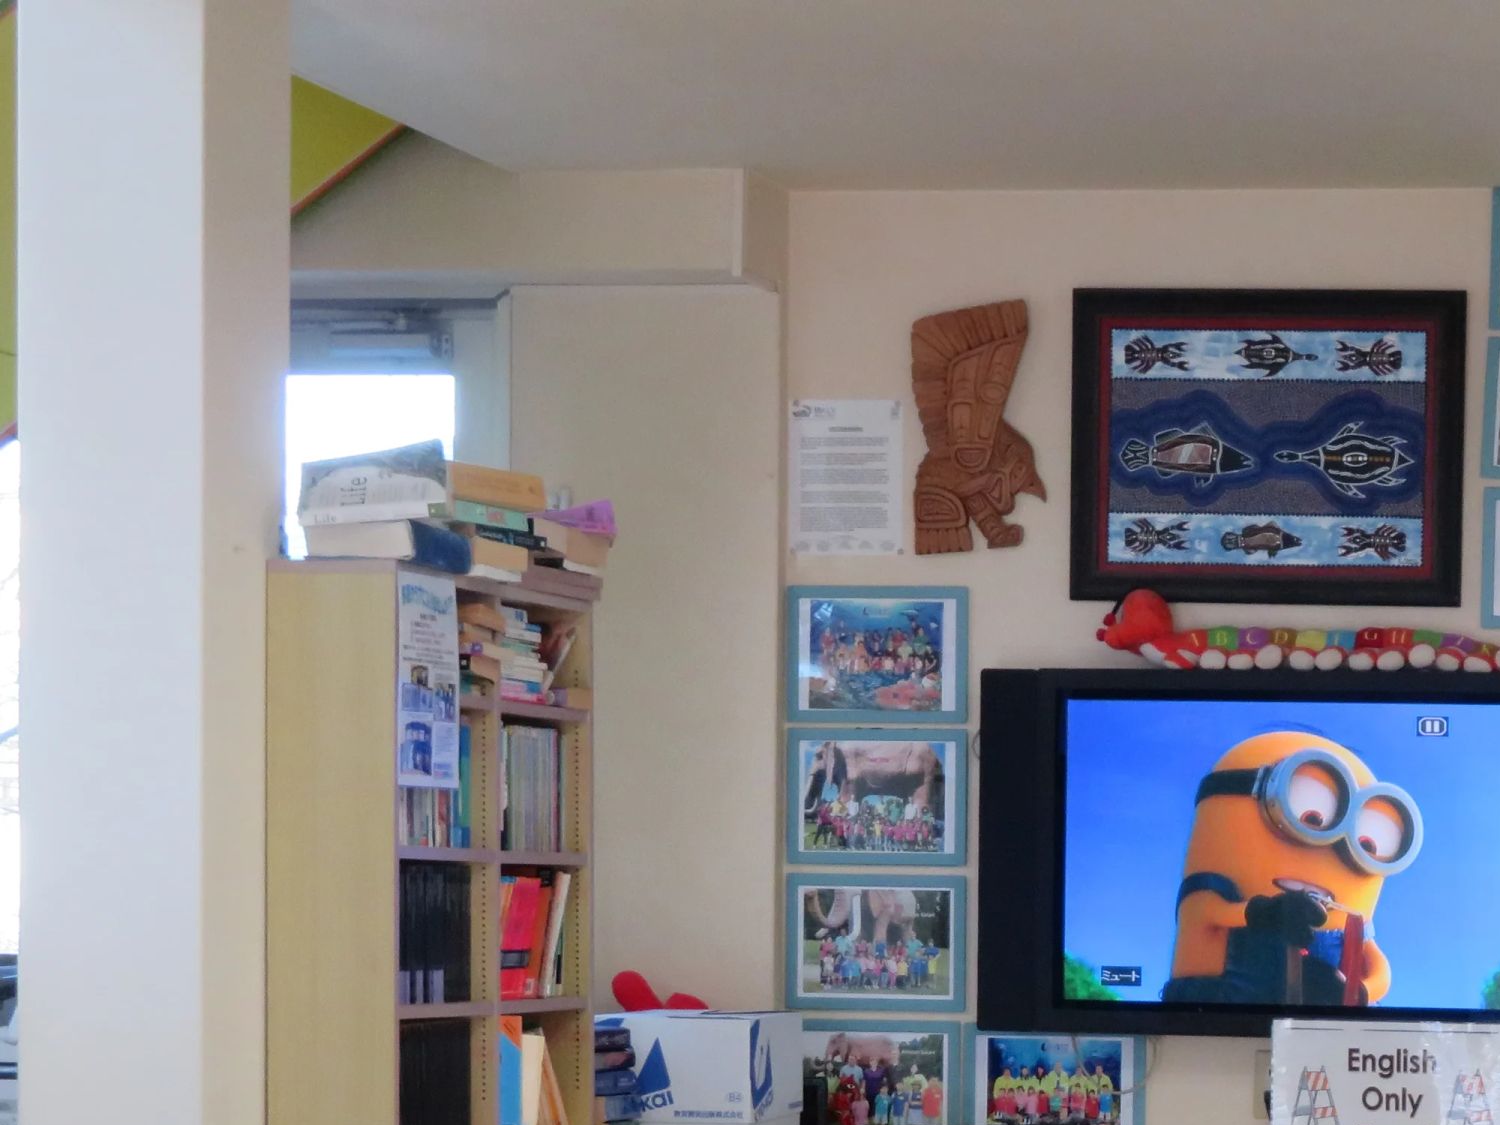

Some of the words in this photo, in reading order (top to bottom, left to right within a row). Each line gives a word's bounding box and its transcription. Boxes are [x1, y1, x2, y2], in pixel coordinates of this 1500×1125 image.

[1101, 969, 1141, 982] ミュート
[1347, 1048, 1437, 1079] English
[1361, 1086, 1424, 1118] Only
